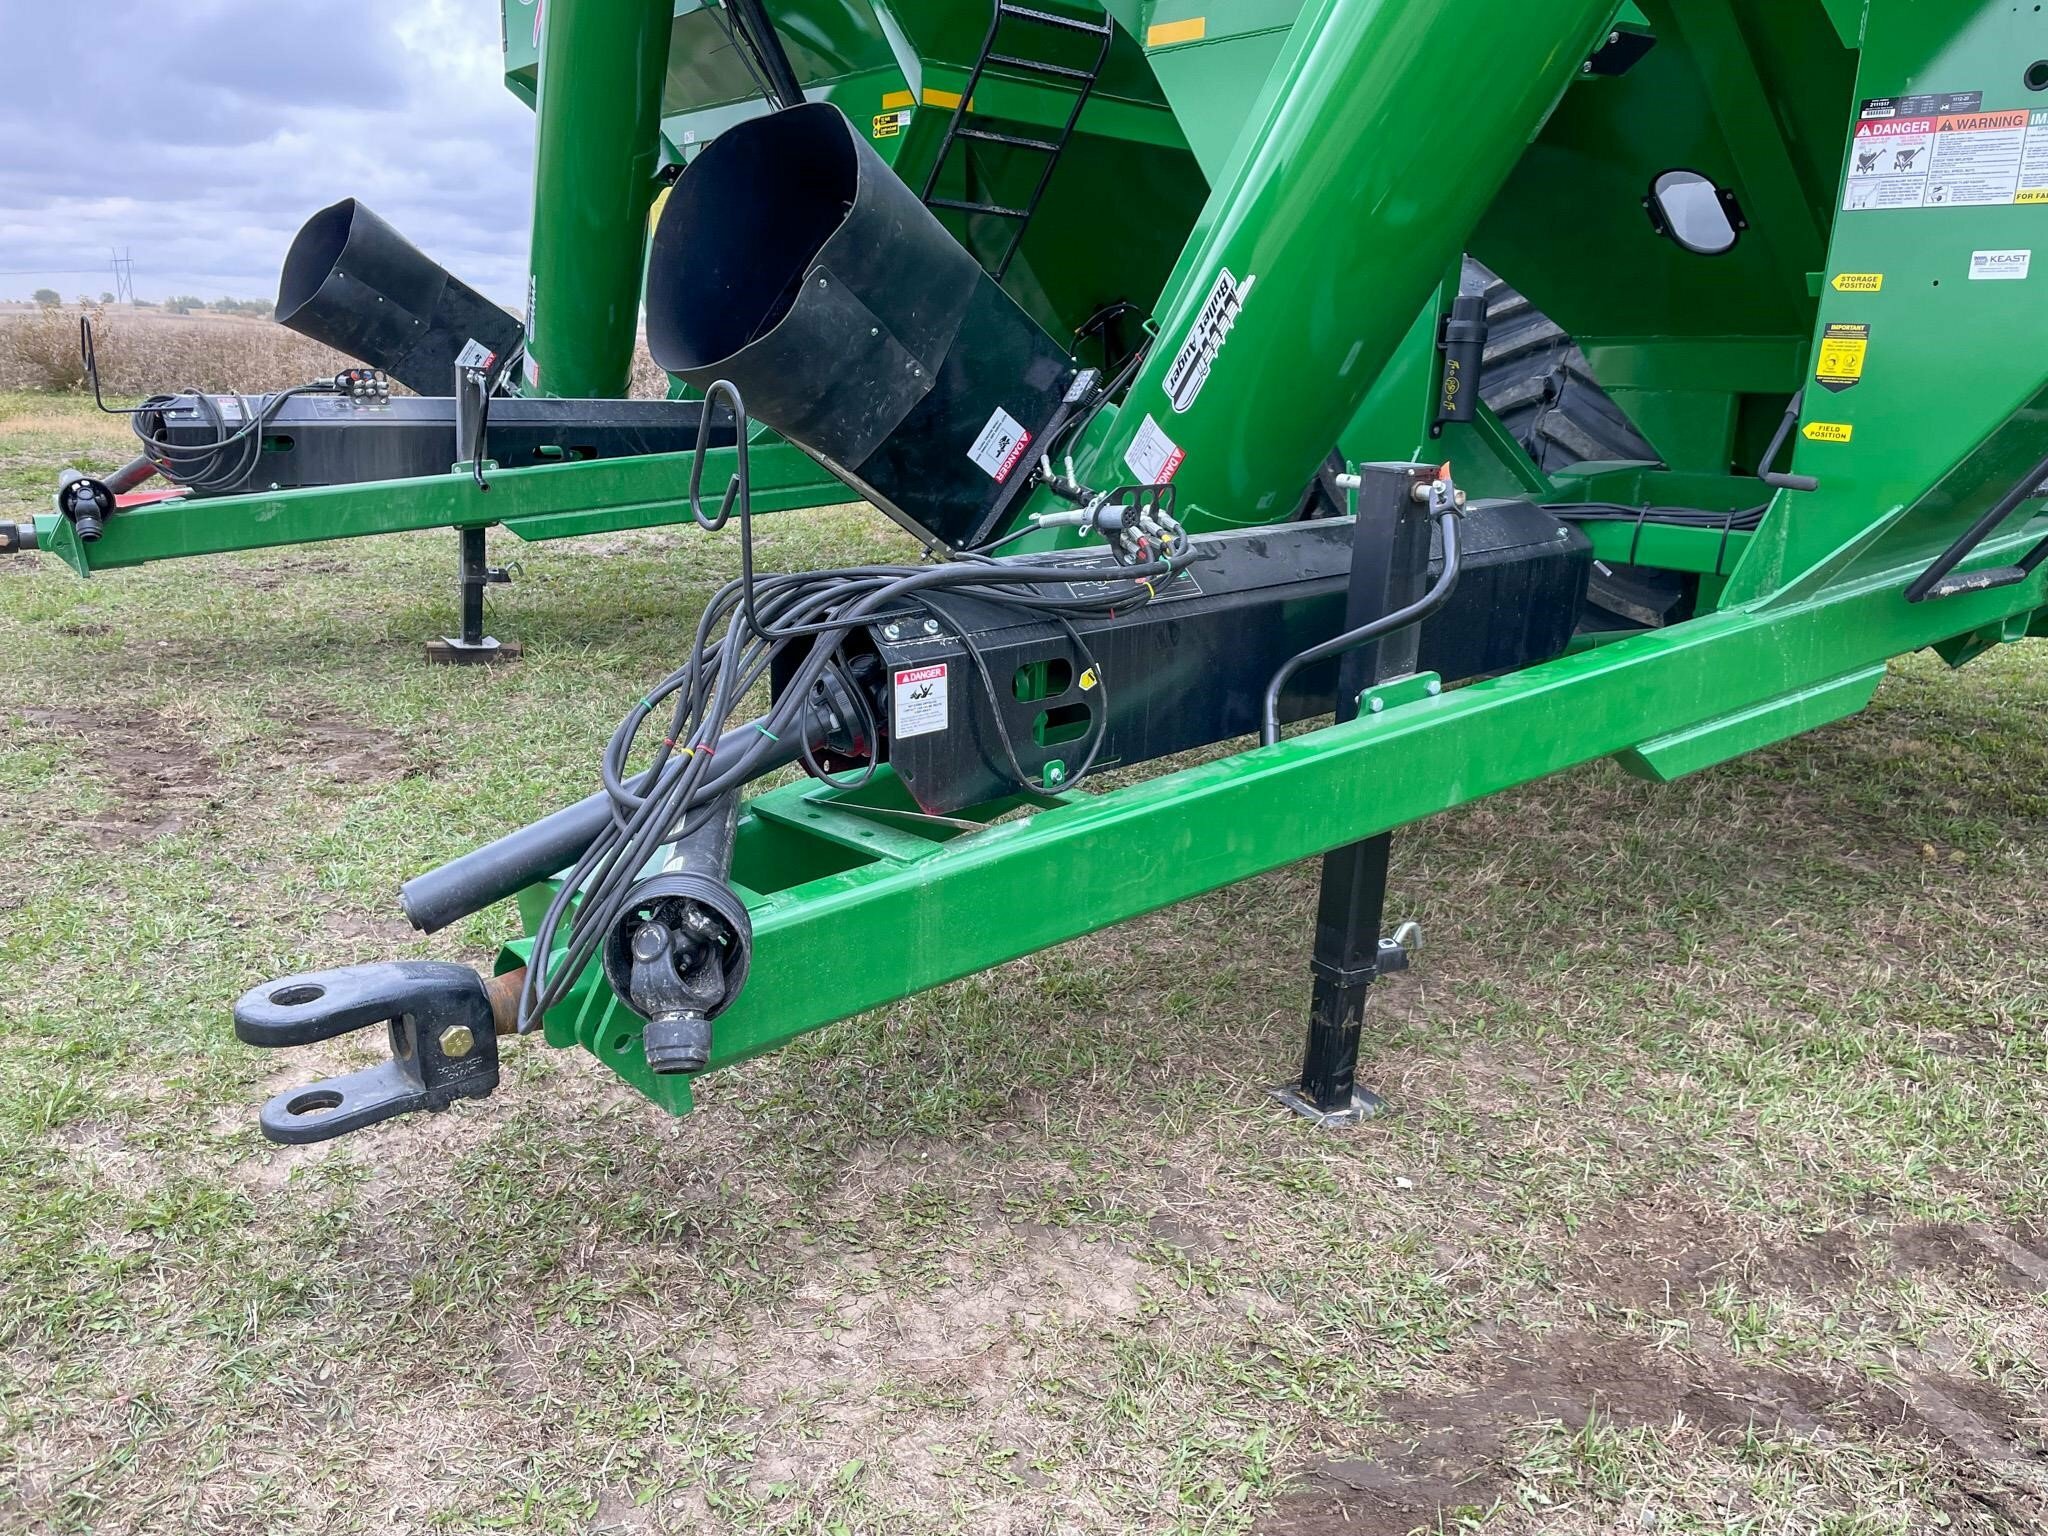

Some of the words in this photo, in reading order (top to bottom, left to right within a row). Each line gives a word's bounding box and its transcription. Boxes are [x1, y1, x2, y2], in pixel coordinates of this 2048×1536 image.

[1873, 121, 1930, 136] DANGER
[1957, 115, 2023, 130] WARNING
[1198, 278, 1229, 335] Bullet
[1170, 335, 1197, 390] Auger
[1810, 431, 1846, 439] POSITION
[996, 442, 1024, 481] DANGER
[910, 668, 941, 681] DANGER
